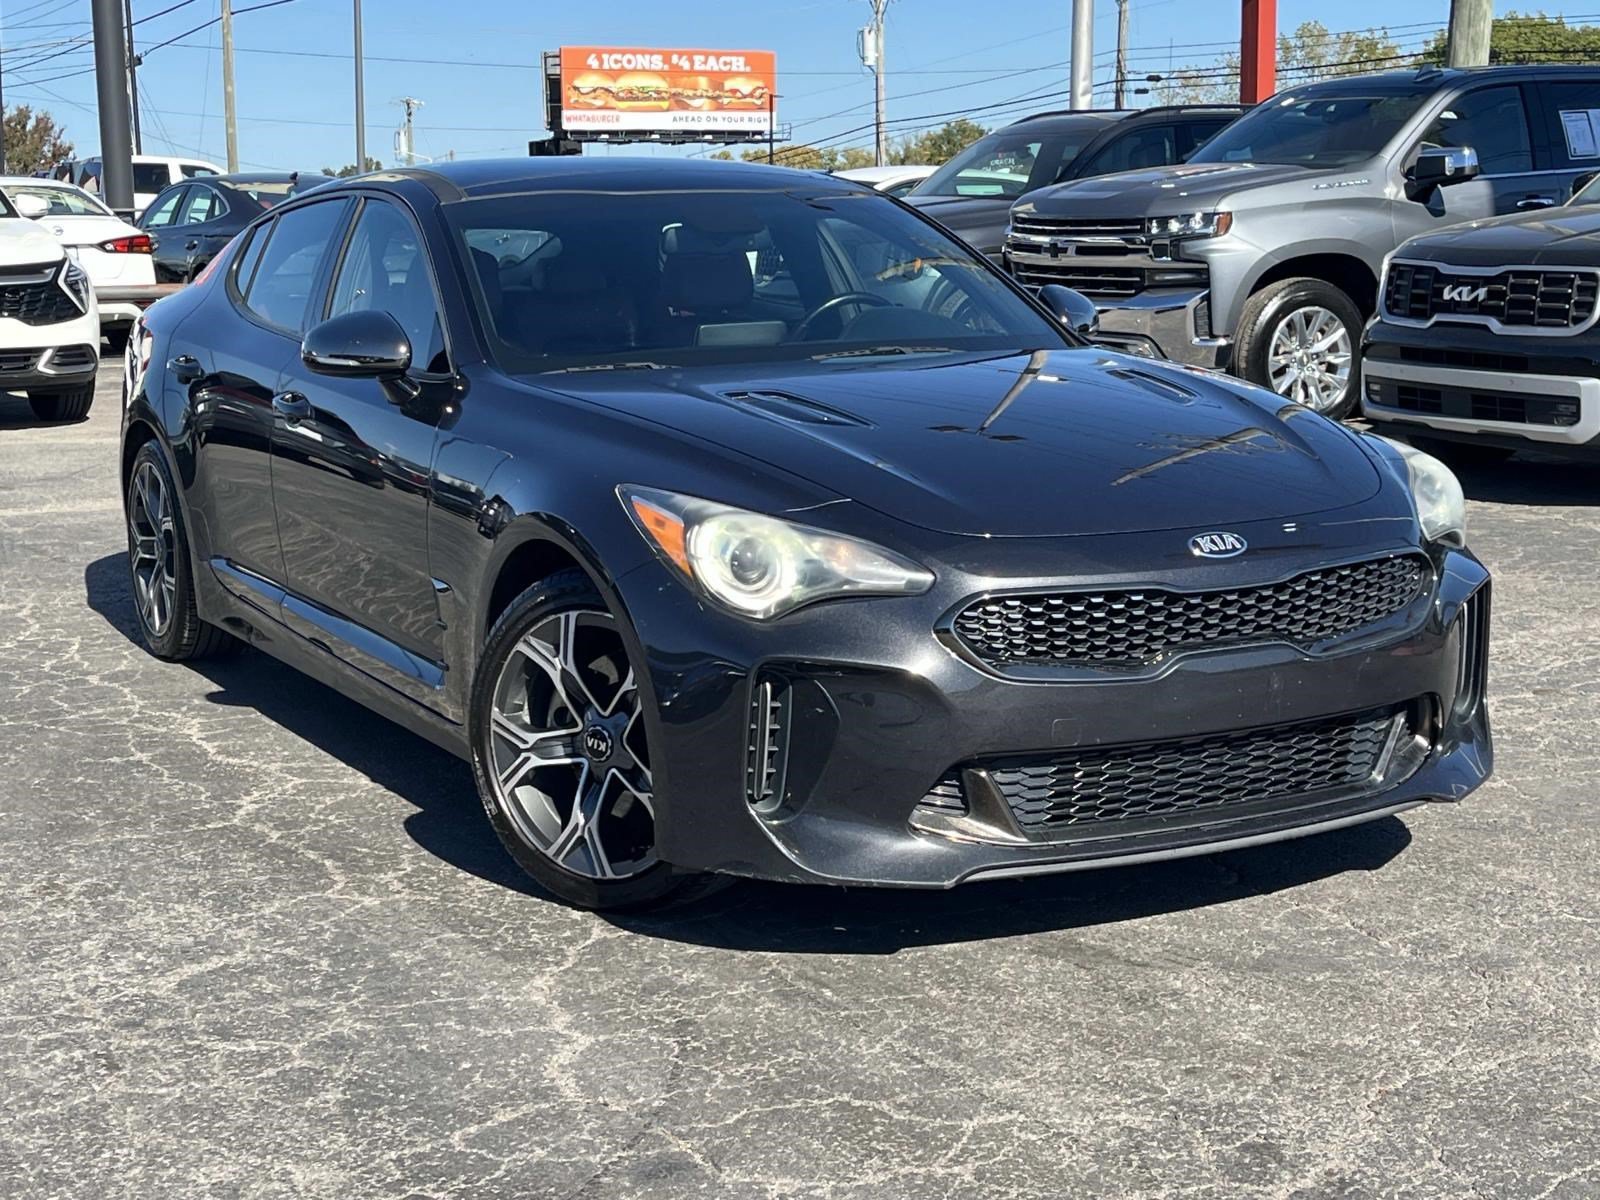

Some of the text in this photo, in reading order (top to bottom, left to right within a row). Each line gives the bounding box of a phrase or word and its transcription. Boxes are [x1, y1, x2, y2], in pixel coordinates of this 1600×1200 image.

[587, 53, 752, 72] 4 ICONS. $4 EACH.
[565, 114, 621, 124] WHATABURGER
[672, 115, 770, 123] AHEAD ON YOUR RIGH
[1194, 534, 1242, 553] KIA
[587, 736, 607, 752] KIA
